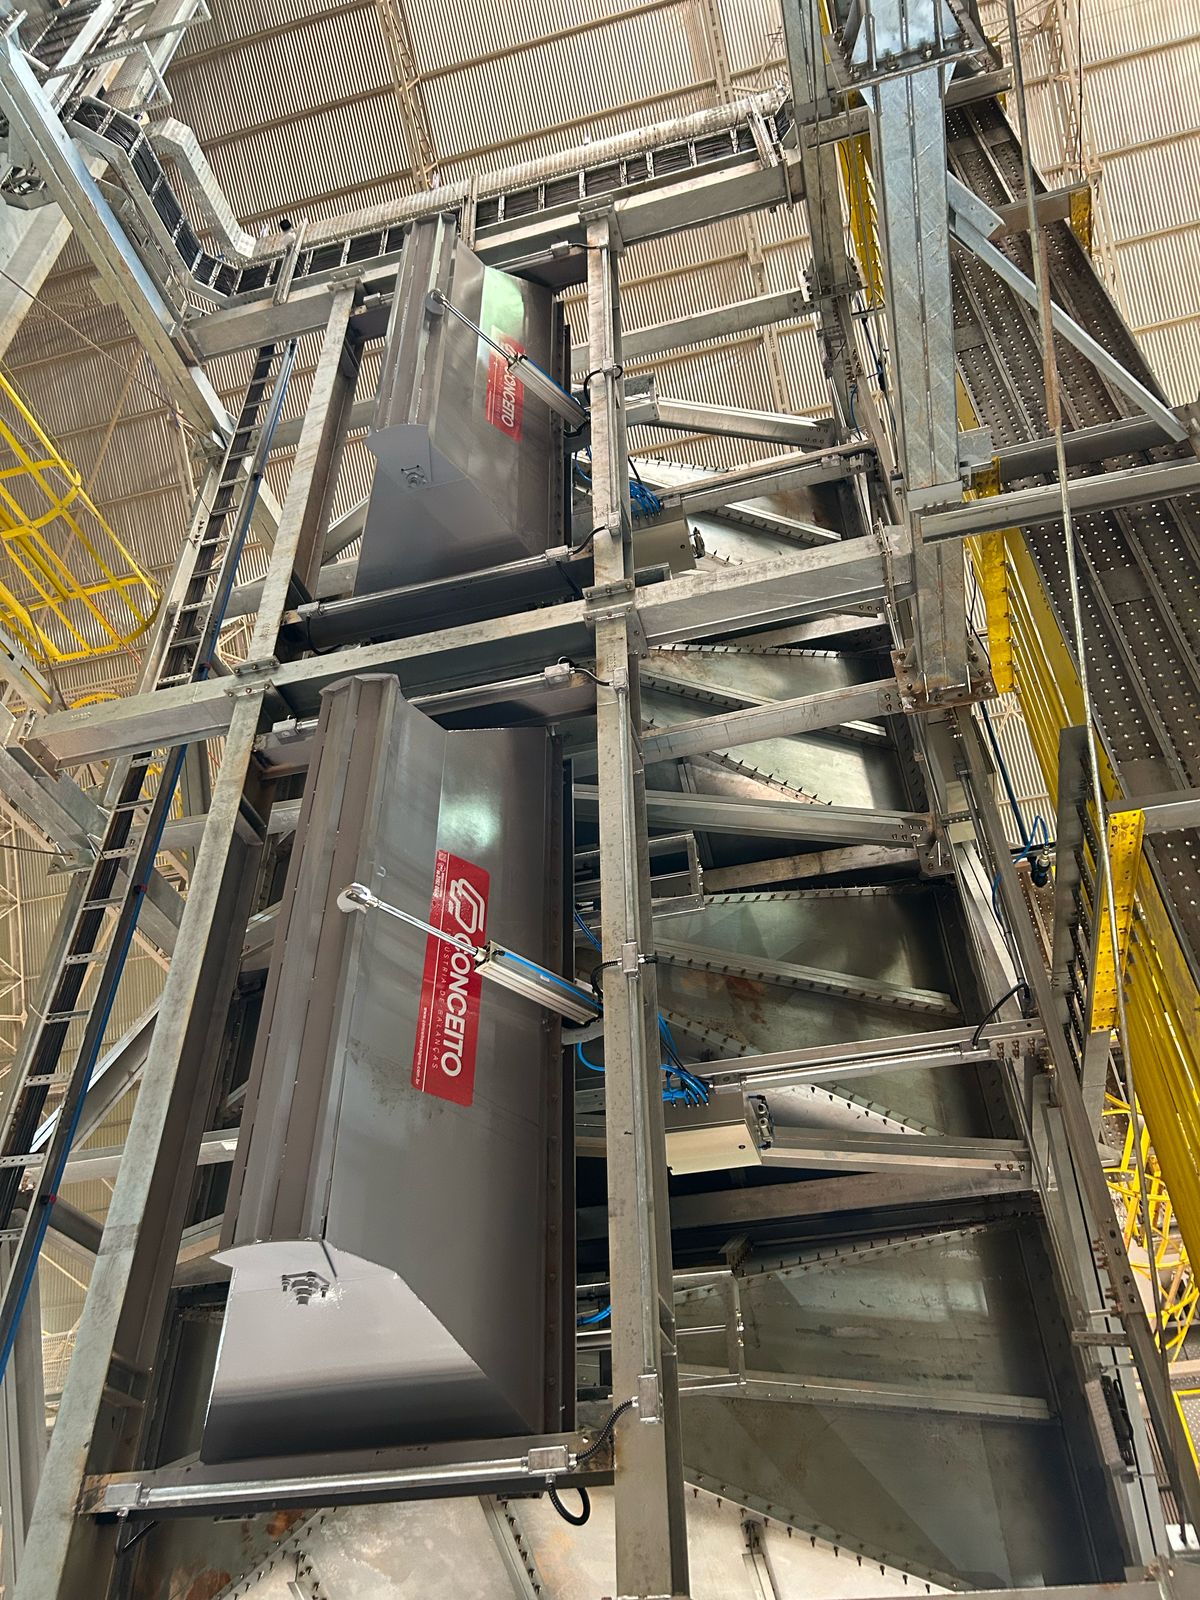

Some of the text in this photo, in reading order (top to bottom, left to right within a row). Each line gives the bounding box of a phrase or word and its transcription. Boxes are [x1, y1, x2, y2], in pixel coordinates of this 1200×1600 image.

[431, 927, 452, 1069] IÚSTRIA DE BALANÇAS
[441, 932, 472, 1077] CONCEITO
